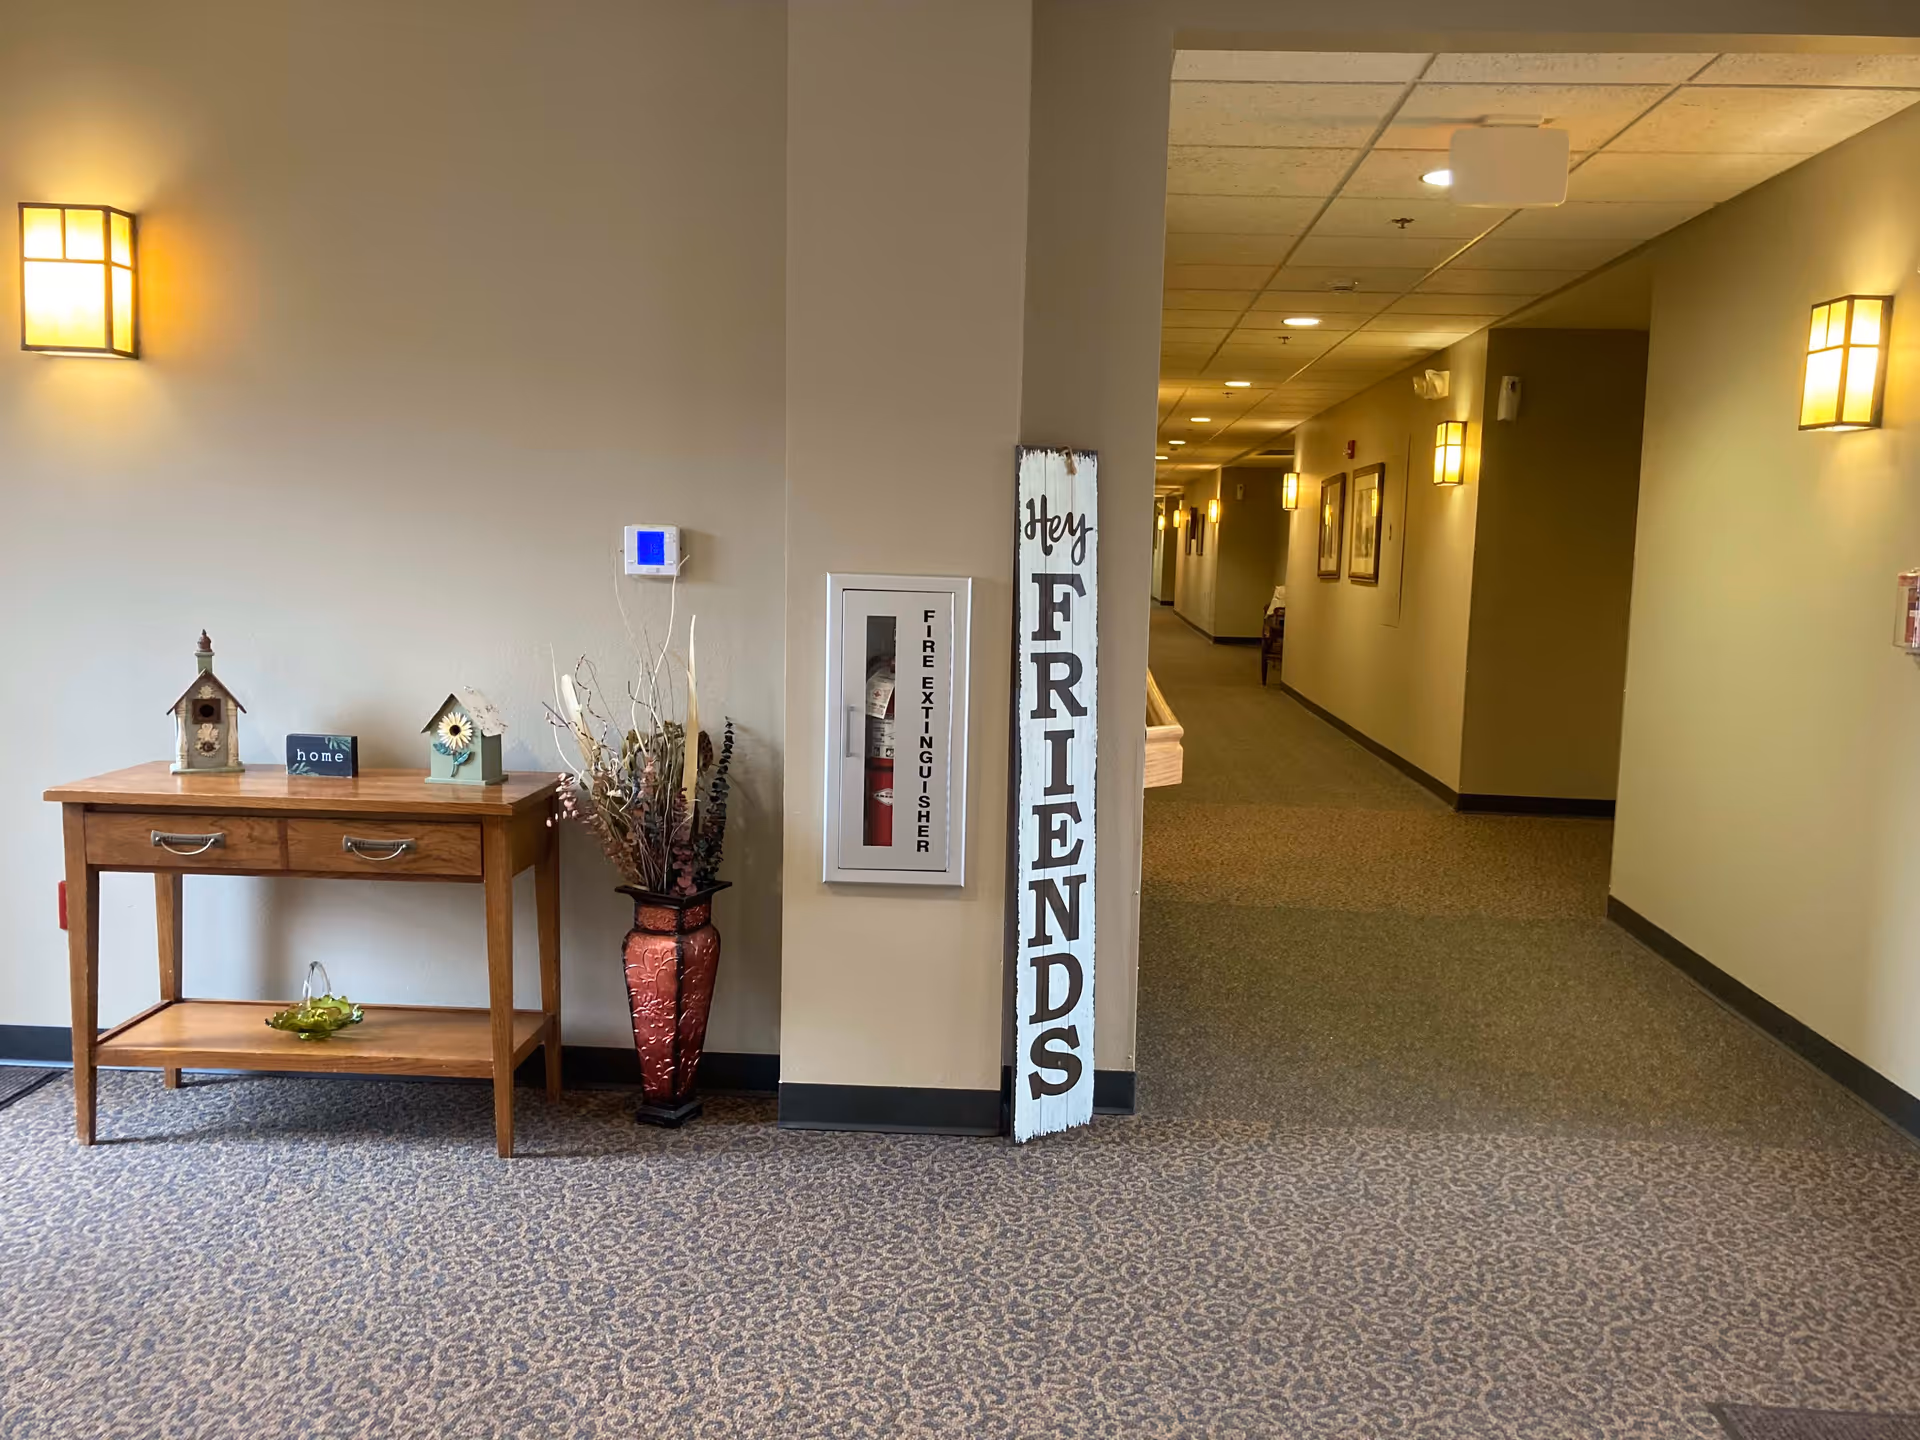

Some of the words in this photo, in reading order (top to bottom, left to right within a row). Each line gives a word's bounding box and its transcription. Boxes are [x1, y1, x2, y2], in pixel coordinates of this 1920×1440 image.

[1024, 494, 1093, 566] Hey
[922, 609, 936, 668] FIRE
[296, 748, 344, 762] home
[916, 676, 934, 853] EXTINGUISHER
[1027, 573, 1087, 1100] FRIENDS
